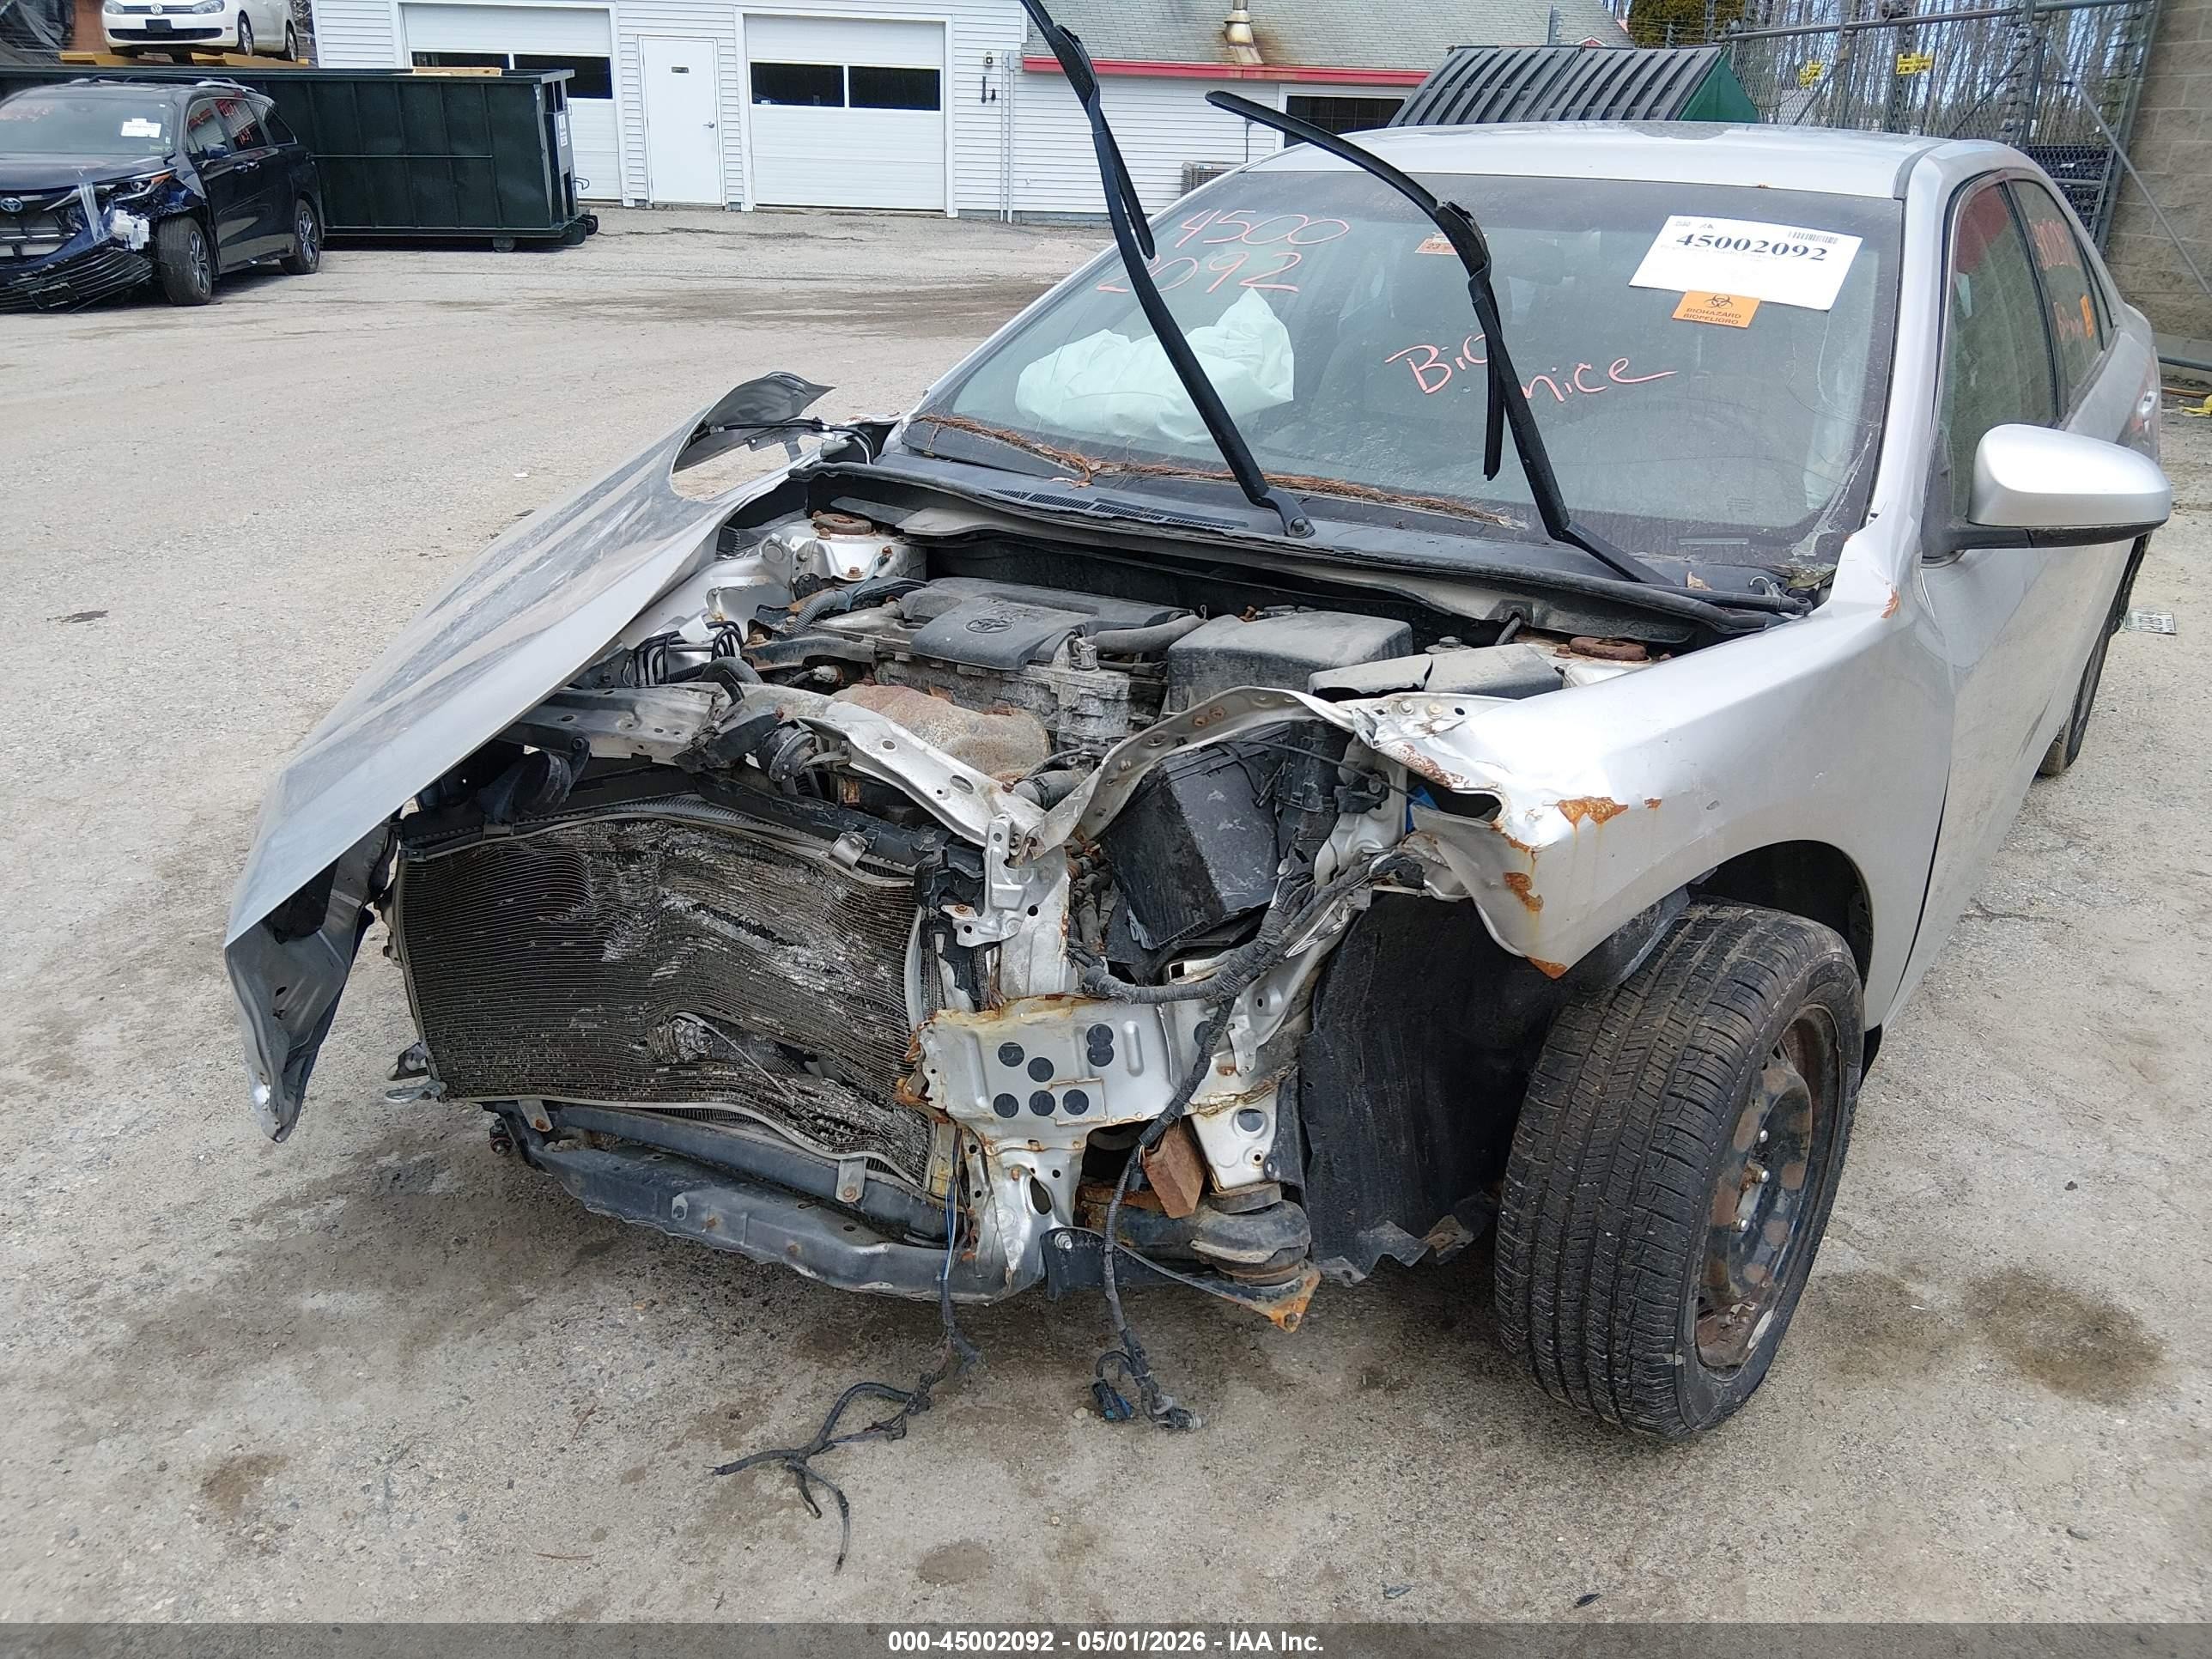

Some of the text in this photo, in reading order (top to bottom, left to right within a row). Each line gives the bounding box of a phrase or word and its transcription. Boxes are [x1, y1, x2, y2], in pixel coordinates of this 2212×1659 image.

[1175, 208, 1351, 248] 4500
[1675, 233, 1829, 262] 45002092
[1683, 313, 1740, 325] BIOPELIGRO
[1686, 307, 1742, 319] BIOHAZARD
